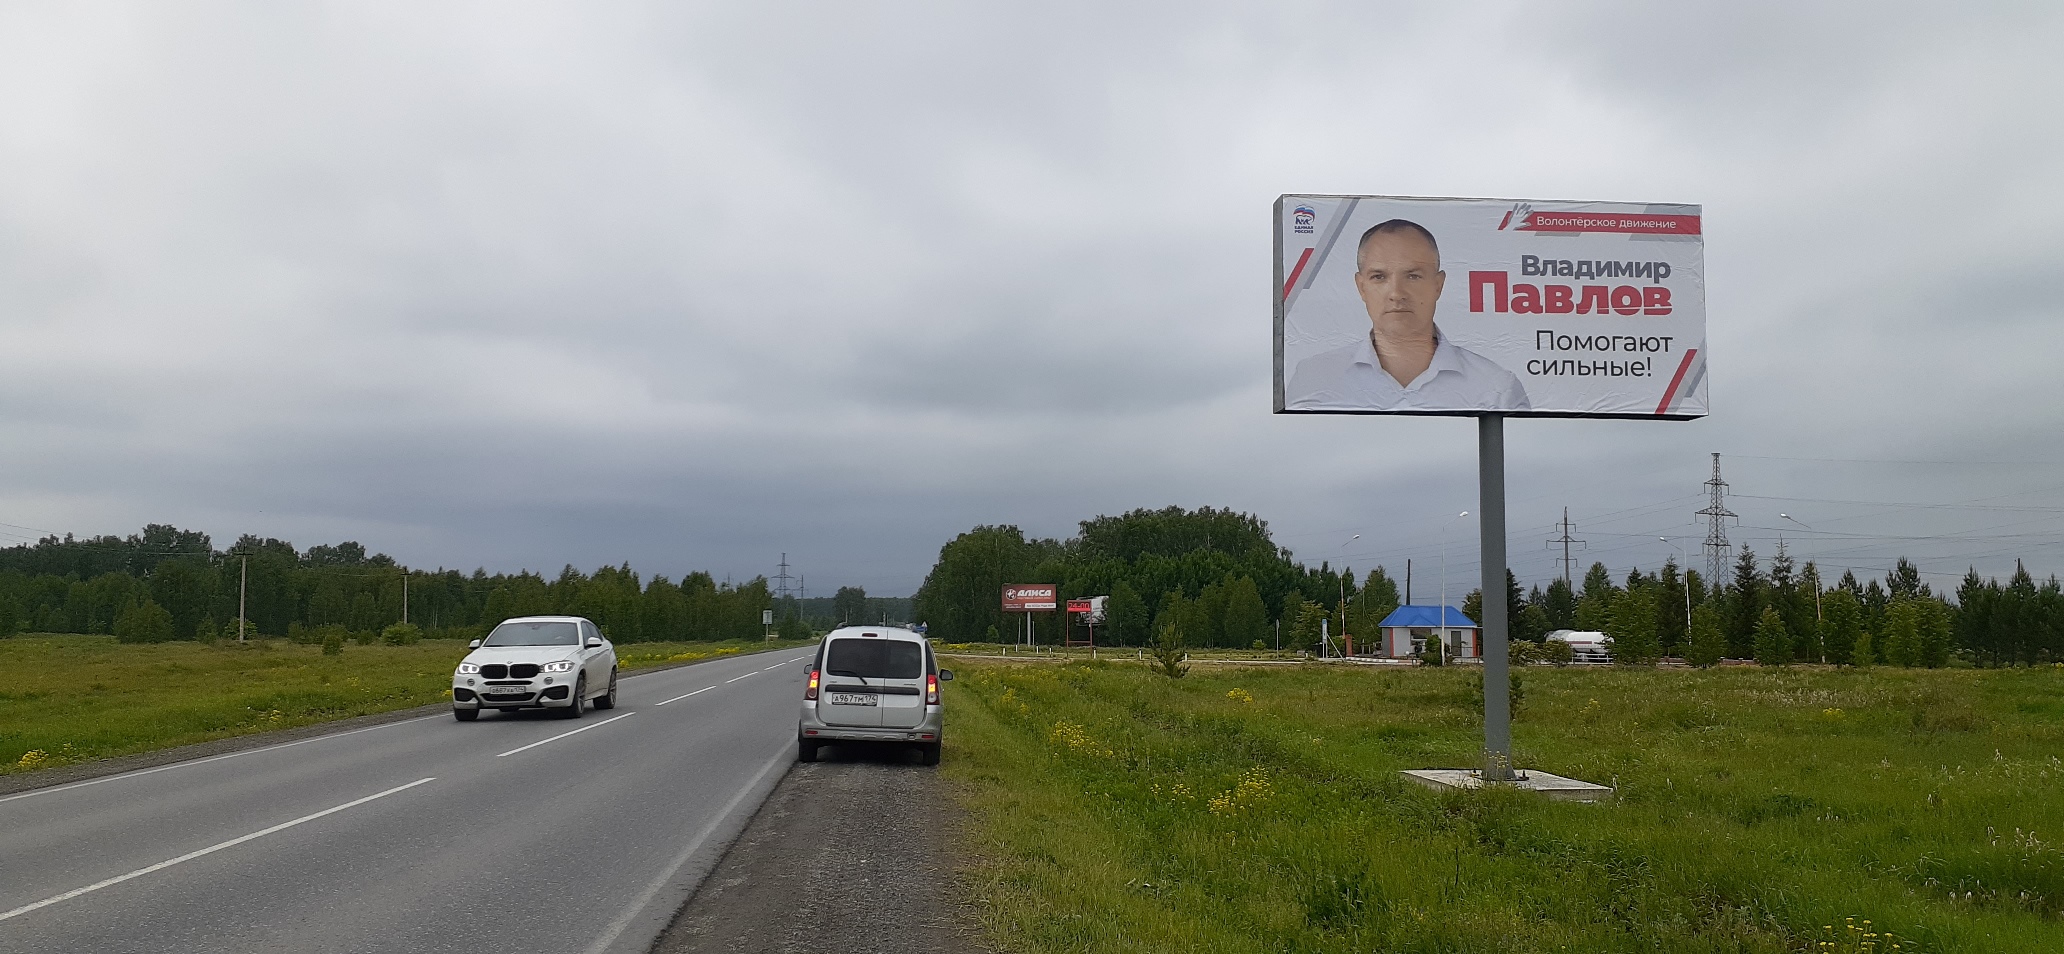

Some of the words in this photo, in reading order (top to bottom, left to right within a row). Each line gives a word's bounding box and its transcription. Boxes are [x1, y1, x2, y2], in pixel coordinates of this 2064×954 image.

[1537, 216, 1616, 228] Волонтёрское
[1619, 219, 1677, 229] движение
[1521, 254, 1672, 284] Владимир
[1469, 270, 1673, 316] Павлов
[1536, 330, 1673, 352] Помогают
[1527, 357, 1652, 377] сильные!
